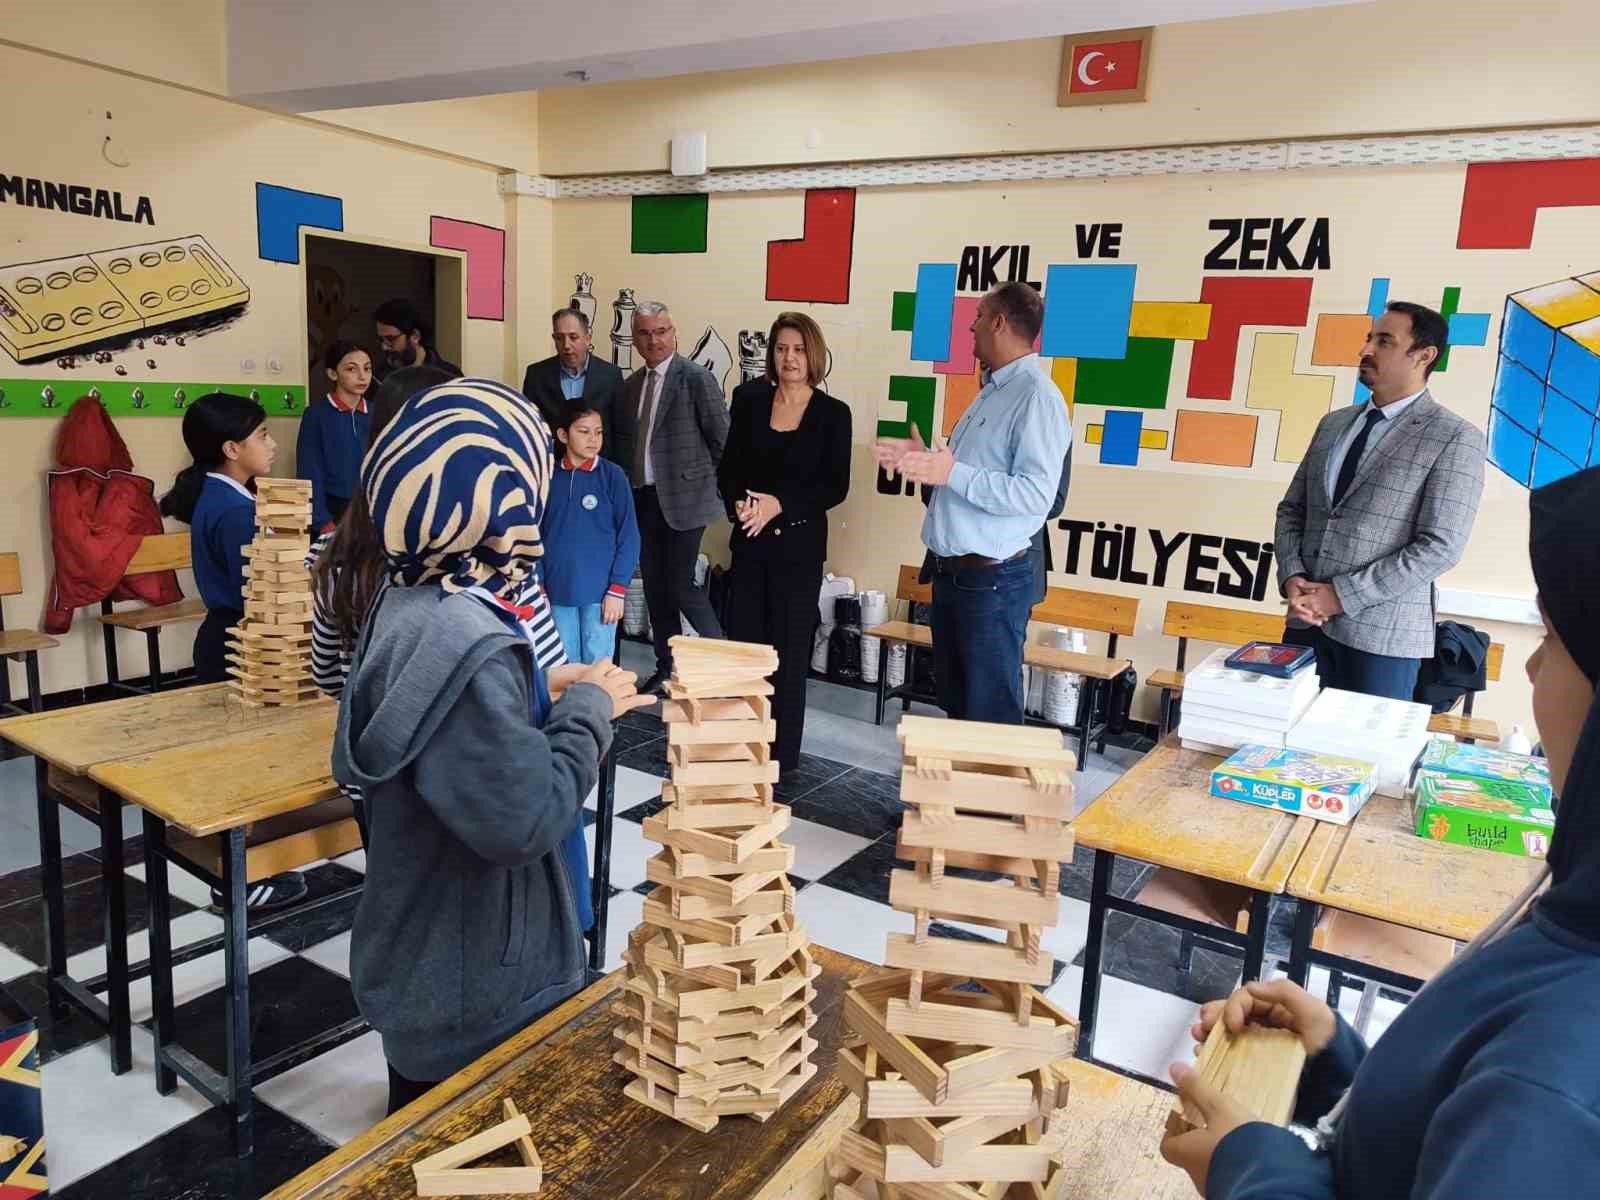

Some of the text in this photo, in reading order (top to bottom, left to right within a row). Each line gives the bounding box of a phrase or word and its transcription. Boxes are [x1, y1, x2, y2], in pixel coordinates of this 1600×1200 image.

[0, 174, 155, 225] MANGALA
[957, 217, 1331, 291] AKIL VE ZEKA
[1046, 518, 1275, 602] TÖLYESİ
